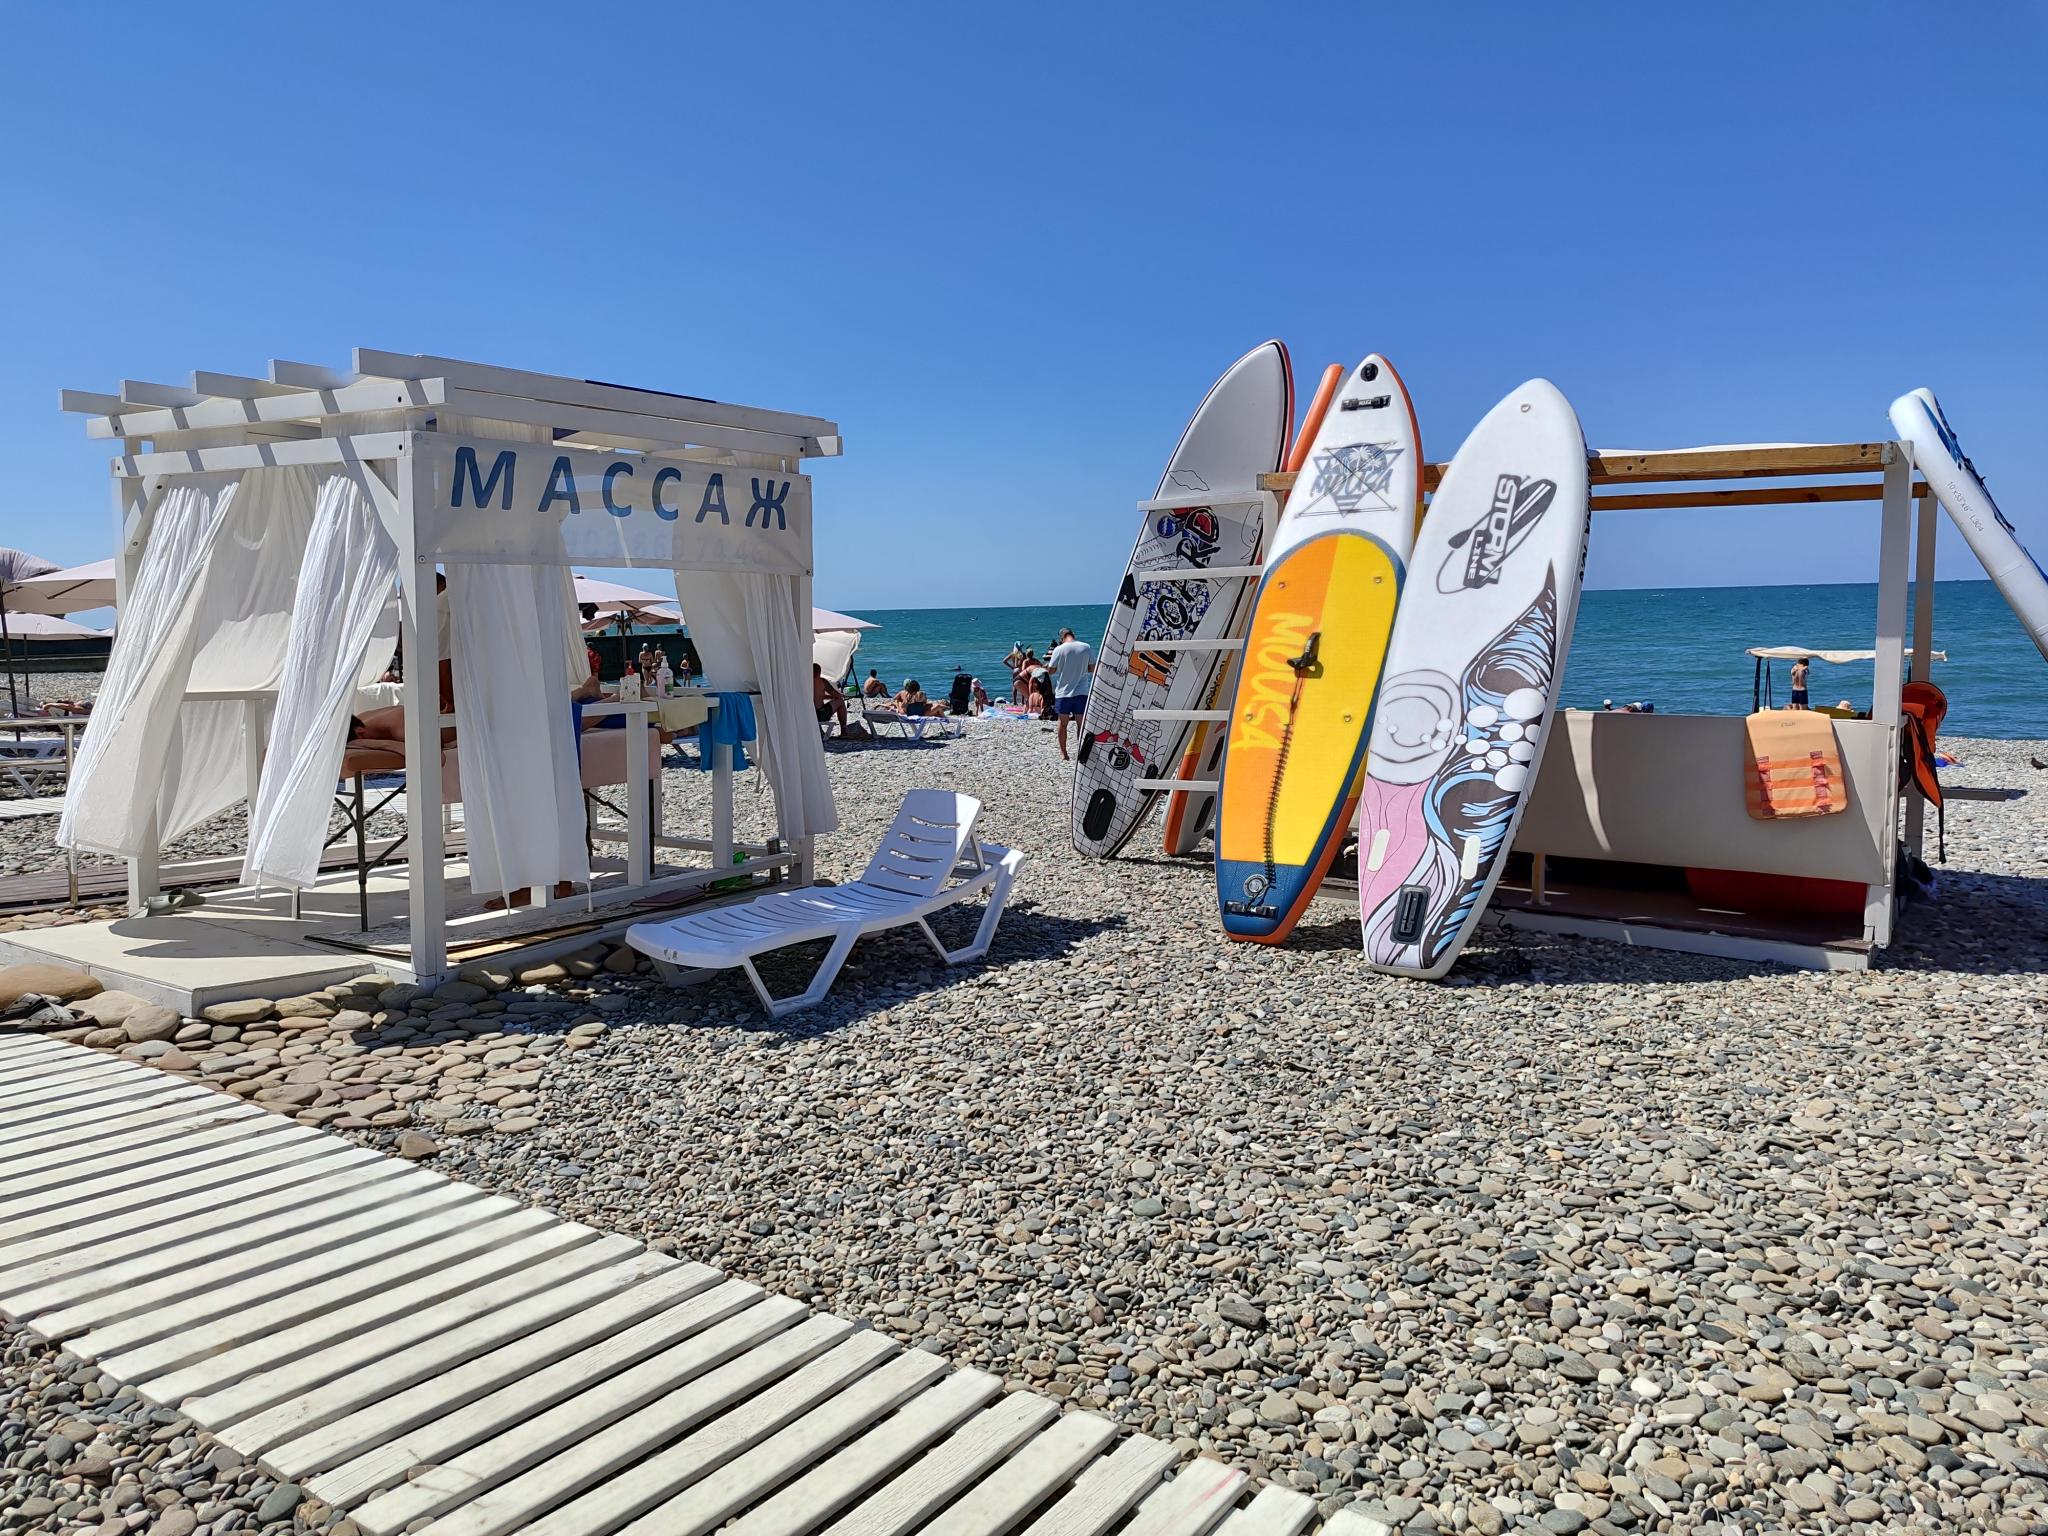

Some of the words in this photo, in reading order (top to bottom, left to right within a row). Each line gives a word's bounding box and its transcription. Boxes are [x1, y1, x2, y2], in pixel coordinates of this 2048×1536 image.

[450, 446, 791, 531] МАССАЖ
[1478, 477, 1518, 580] STORM
[1467, 535, 1485, 581] LINE
[1231, 612, 1314, 750] MOUSA
